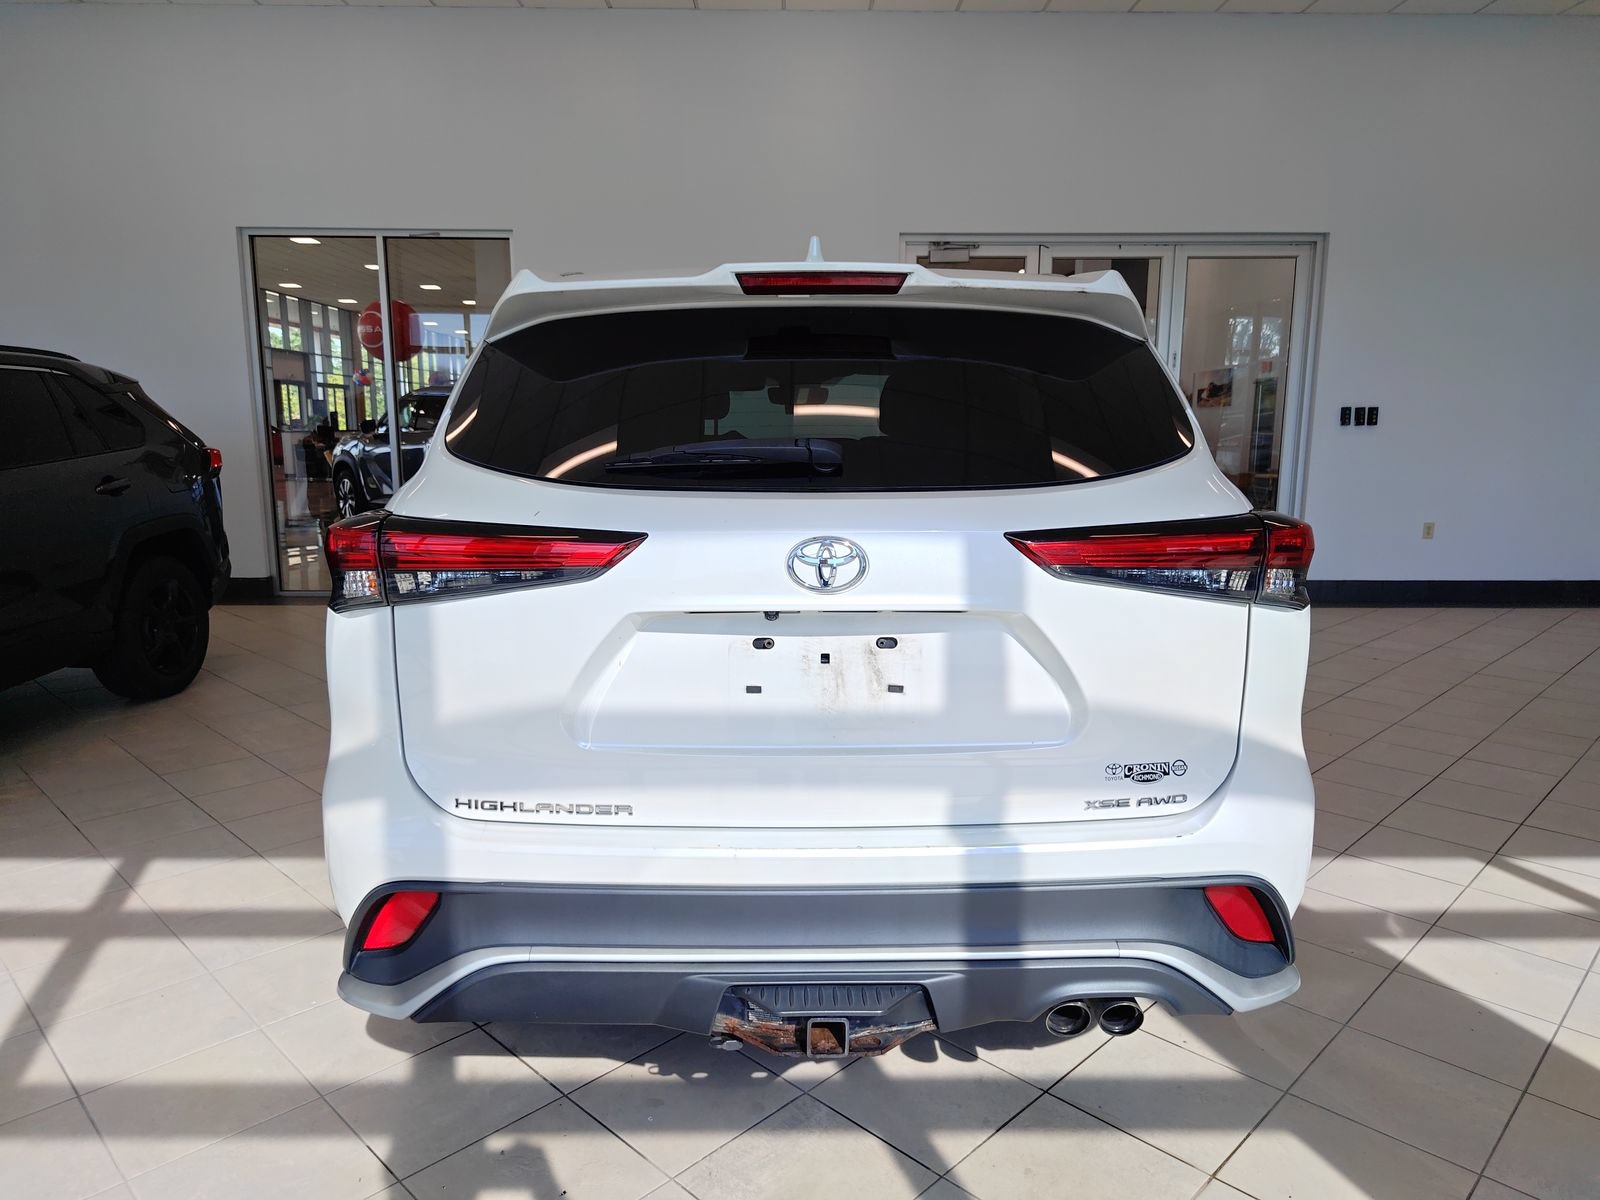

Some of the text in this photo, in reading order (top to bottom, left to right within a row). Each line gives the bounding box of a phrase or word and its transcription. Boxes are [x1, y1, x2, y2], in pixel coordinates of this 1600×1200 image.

[1125, 762, 1169, 776] CRONIN
[1133, 773, 1162, 781] RICHMOND
[454, 798, 633, 816] HIGHLANDER
[1083, 794, 1188, 811] XSE AWD
